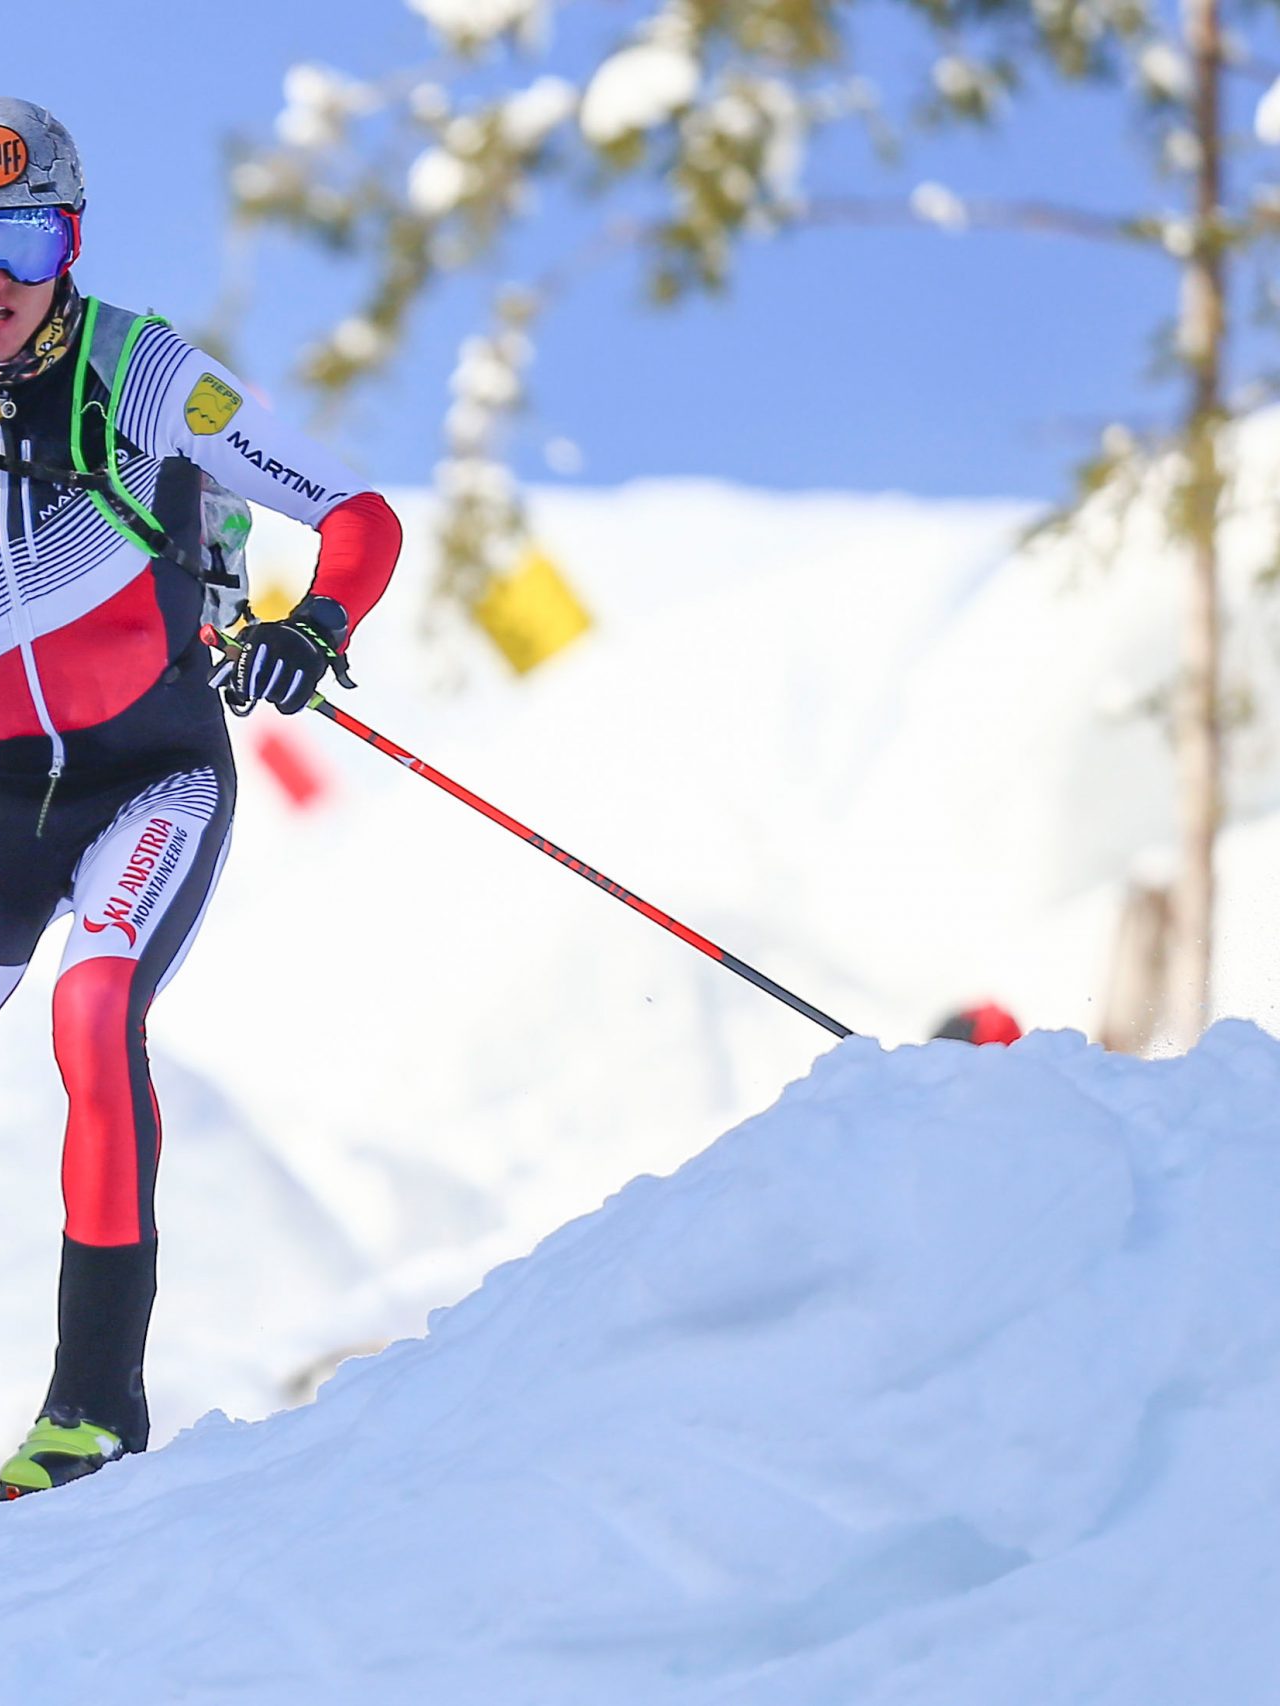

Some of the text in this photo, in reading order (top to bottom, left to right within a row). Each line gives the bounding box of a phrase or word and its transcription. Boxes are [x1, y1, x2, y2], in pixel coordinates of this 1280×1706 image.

[202, 376, 239, 406] PIEPS
[226, 430, 326, 503] MARTINI
[82, 817, 174, 950] SKI AUSTRIA
[130, 826, 189, 929] MOUNTAINEERING
